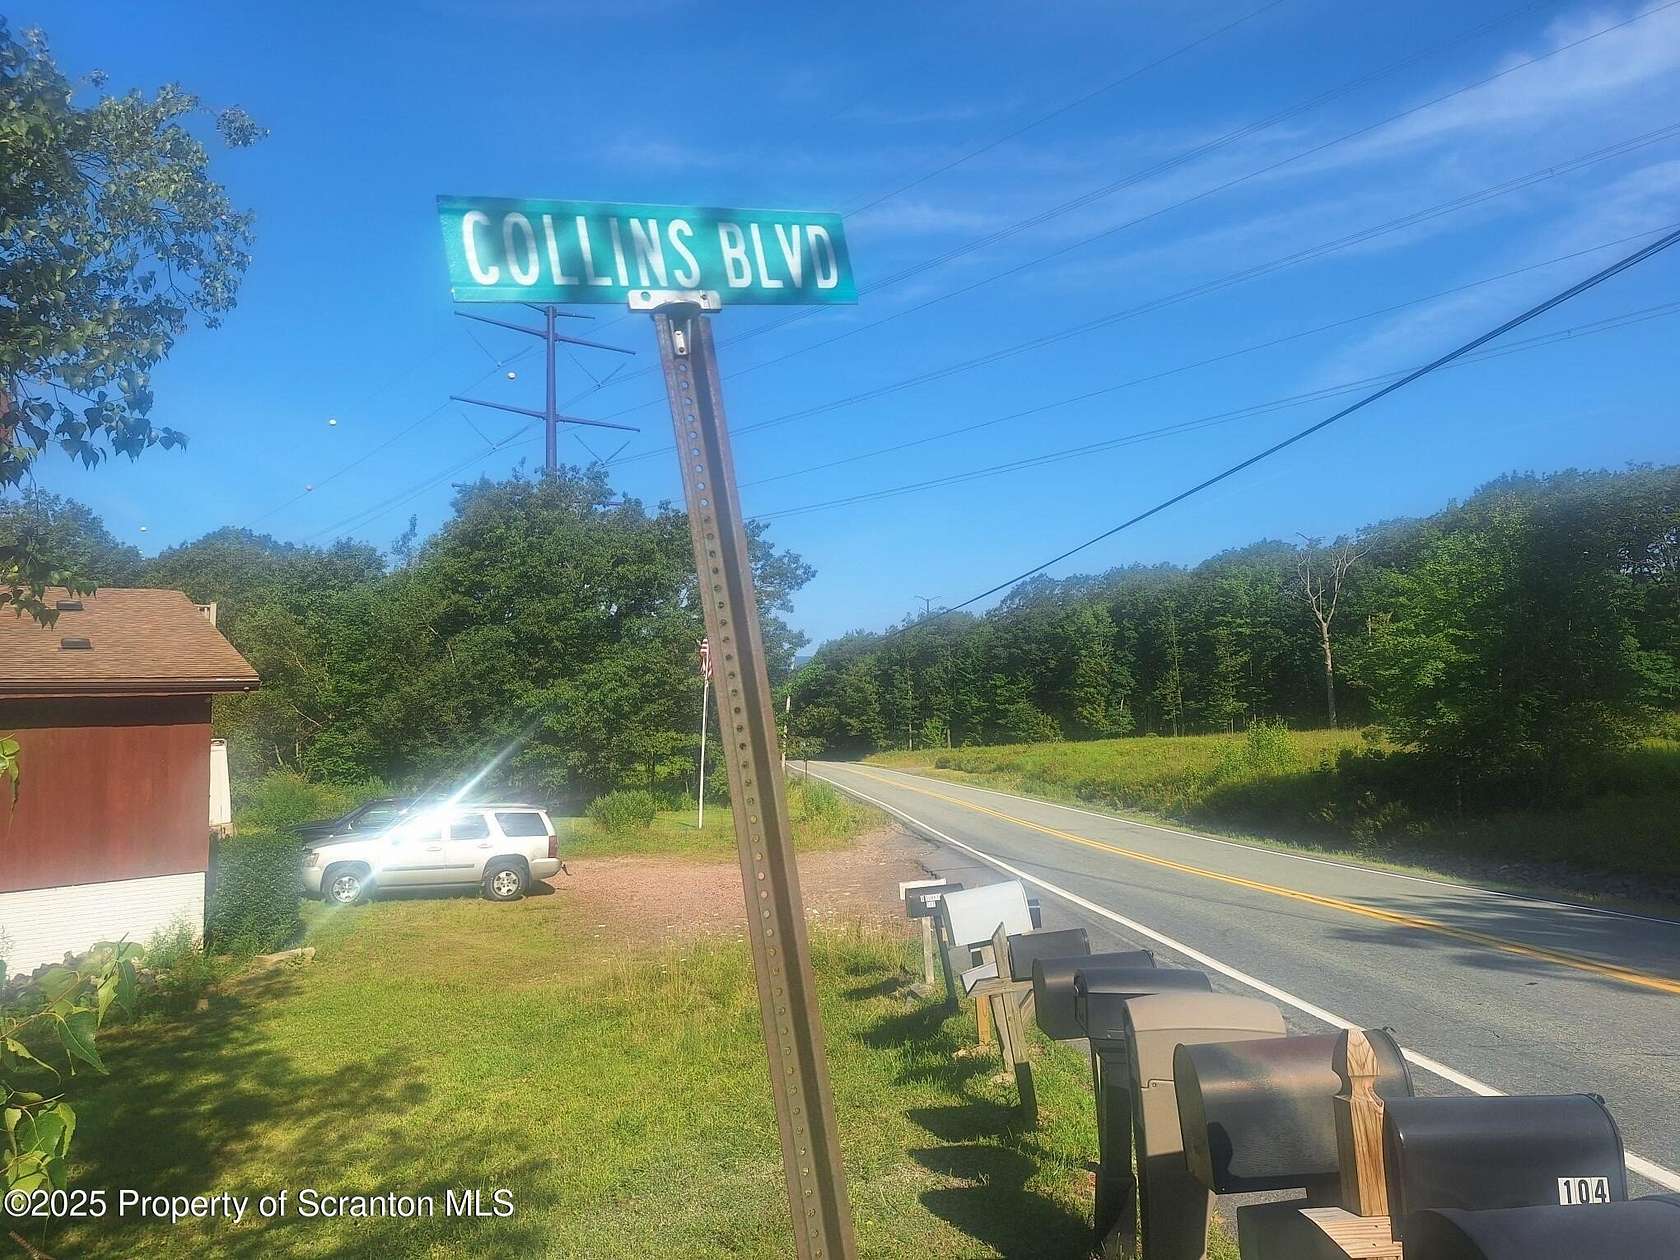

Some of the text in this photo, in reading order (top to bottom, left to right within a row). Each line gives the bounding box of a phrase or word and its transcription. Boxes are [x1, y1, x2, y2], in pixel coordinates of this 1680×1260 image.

[462, 211, 839, 289] COLLINS BLVD
[1562, 1179, 1607, 1204] 104
